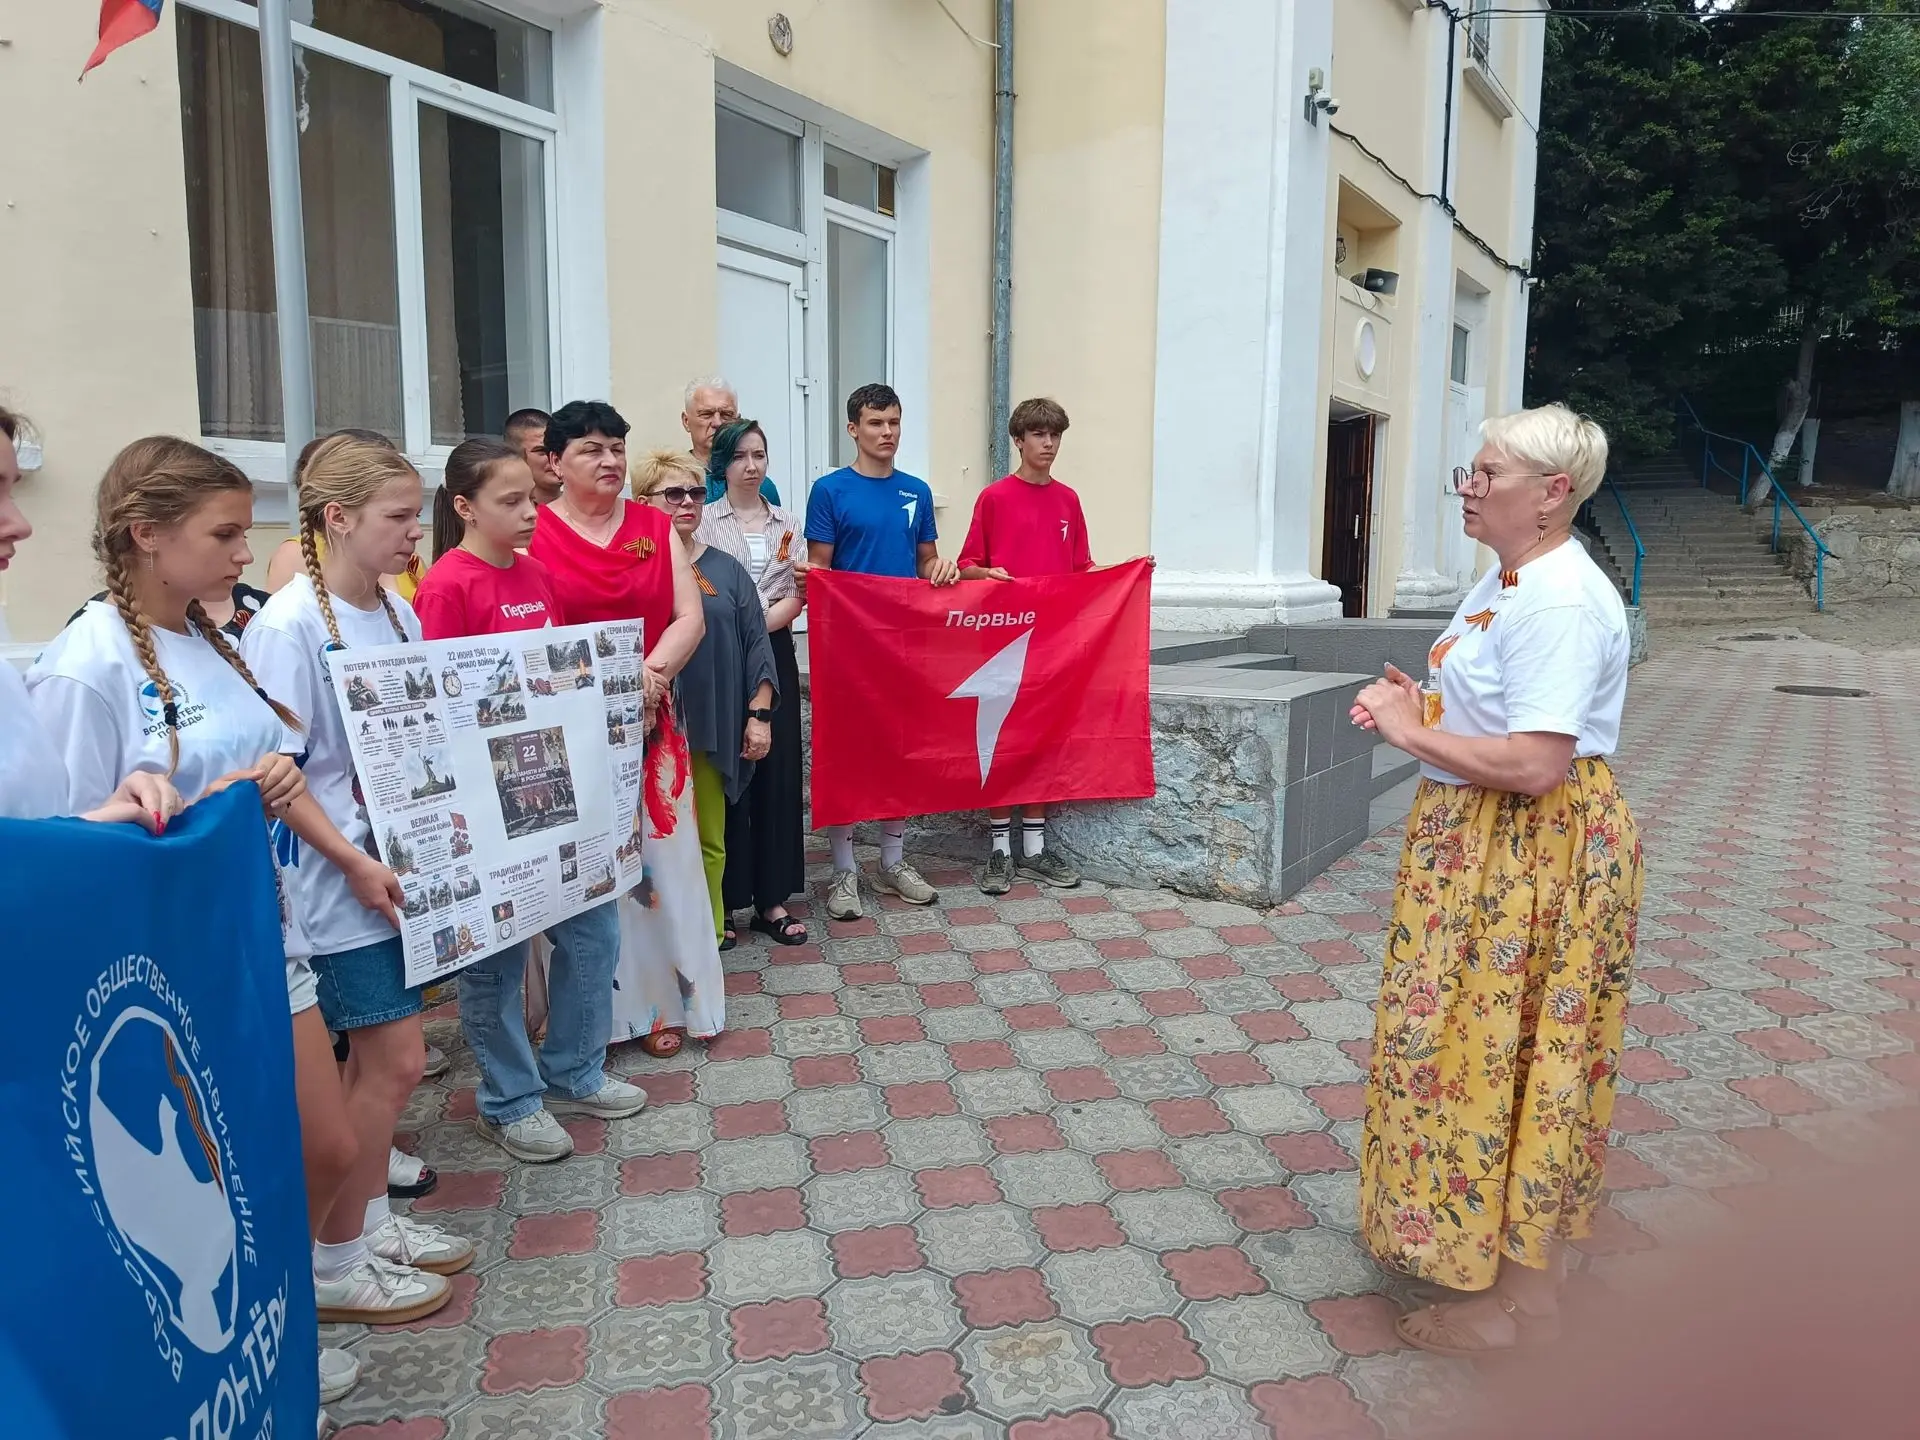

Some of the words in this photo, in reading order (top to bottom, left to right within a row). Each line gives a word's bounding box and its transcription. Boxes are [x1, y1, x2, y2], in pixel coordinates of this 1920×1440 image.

[500, 601, 546, 619] Первые
[945, 610, 1036, 631] Первые
[344, 662, 371, 672] ПОТЕРИ
[377, 658, 406, 669] ТРАГЕДИЯ
[407, 654, 428, 665] ВОЙНЫ
[447, 651, 456, 661] 22
[456, 650, 473, 660] ИЮНЯ
[474, 648, 487, 657] 1941
[487, 647, 500, 656] ГОДА
[456, 660, 477, 670] НАЧАЛО
[522, 745, 537, 758] 22
[401, 826, 437, 840] ОТЕЧЕСТВЕННАЯ
[437, 820, 452, 831] ВОЙНА
[410, 813, 439, 829] ВЕЛИКАЯ
[489, 864, 522, 880] ТРАДИЦИИ
[522, 860, 530, 869] 22
[531, 855, 549, 866] ИЮНЯ
[508, 869, 535, 884] СЕГОДНЯ
[85, 954, 202, 1064] ОБЩЕСТВЕННОЕ
[201, 1065, 258, 1267] ДВИЖЕНИЕ
